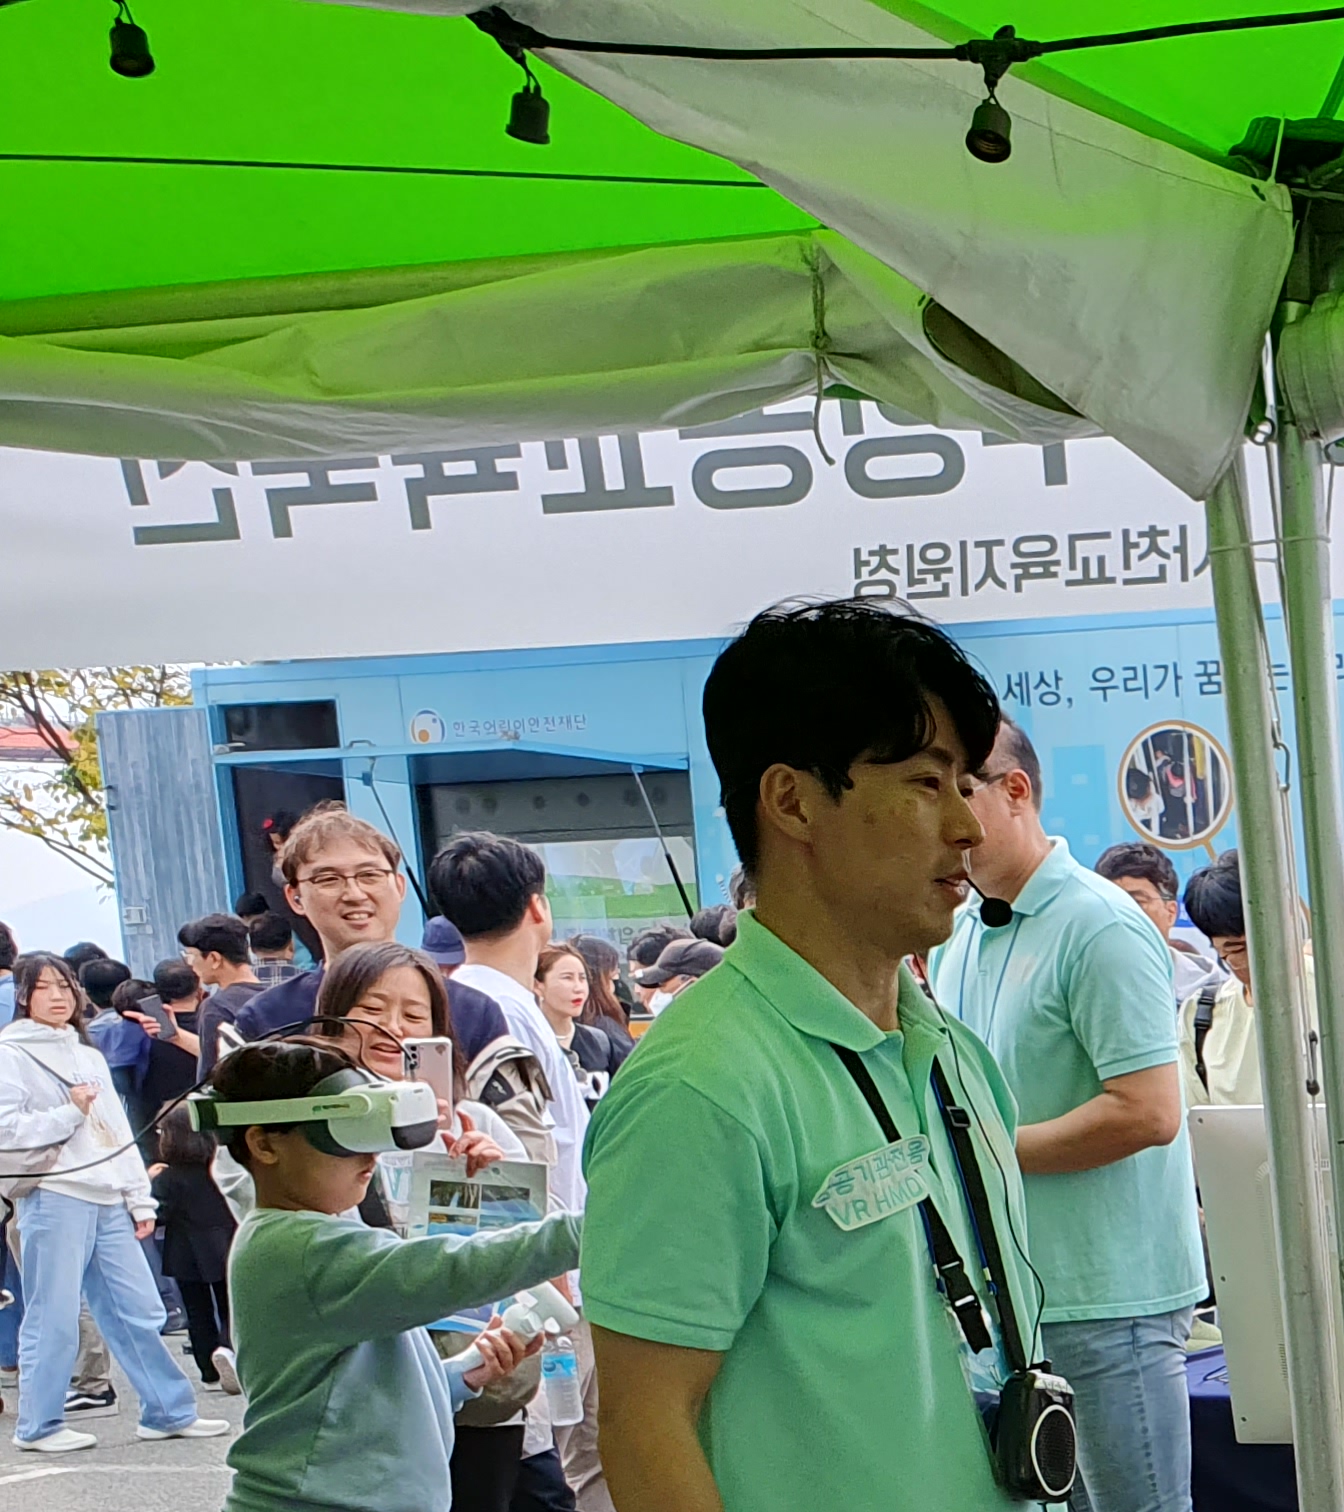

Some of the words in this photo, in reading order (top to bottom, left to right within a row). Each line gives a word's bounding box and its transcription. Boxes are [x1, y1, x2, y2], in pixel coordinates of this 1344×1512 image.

[1003, 668, 1073, 708] 세상,
[1089, 662, 1182, 702] 우리가
[832, 1199, 871, 1227] VR
[874, 1176, 924, 1212] HMD
